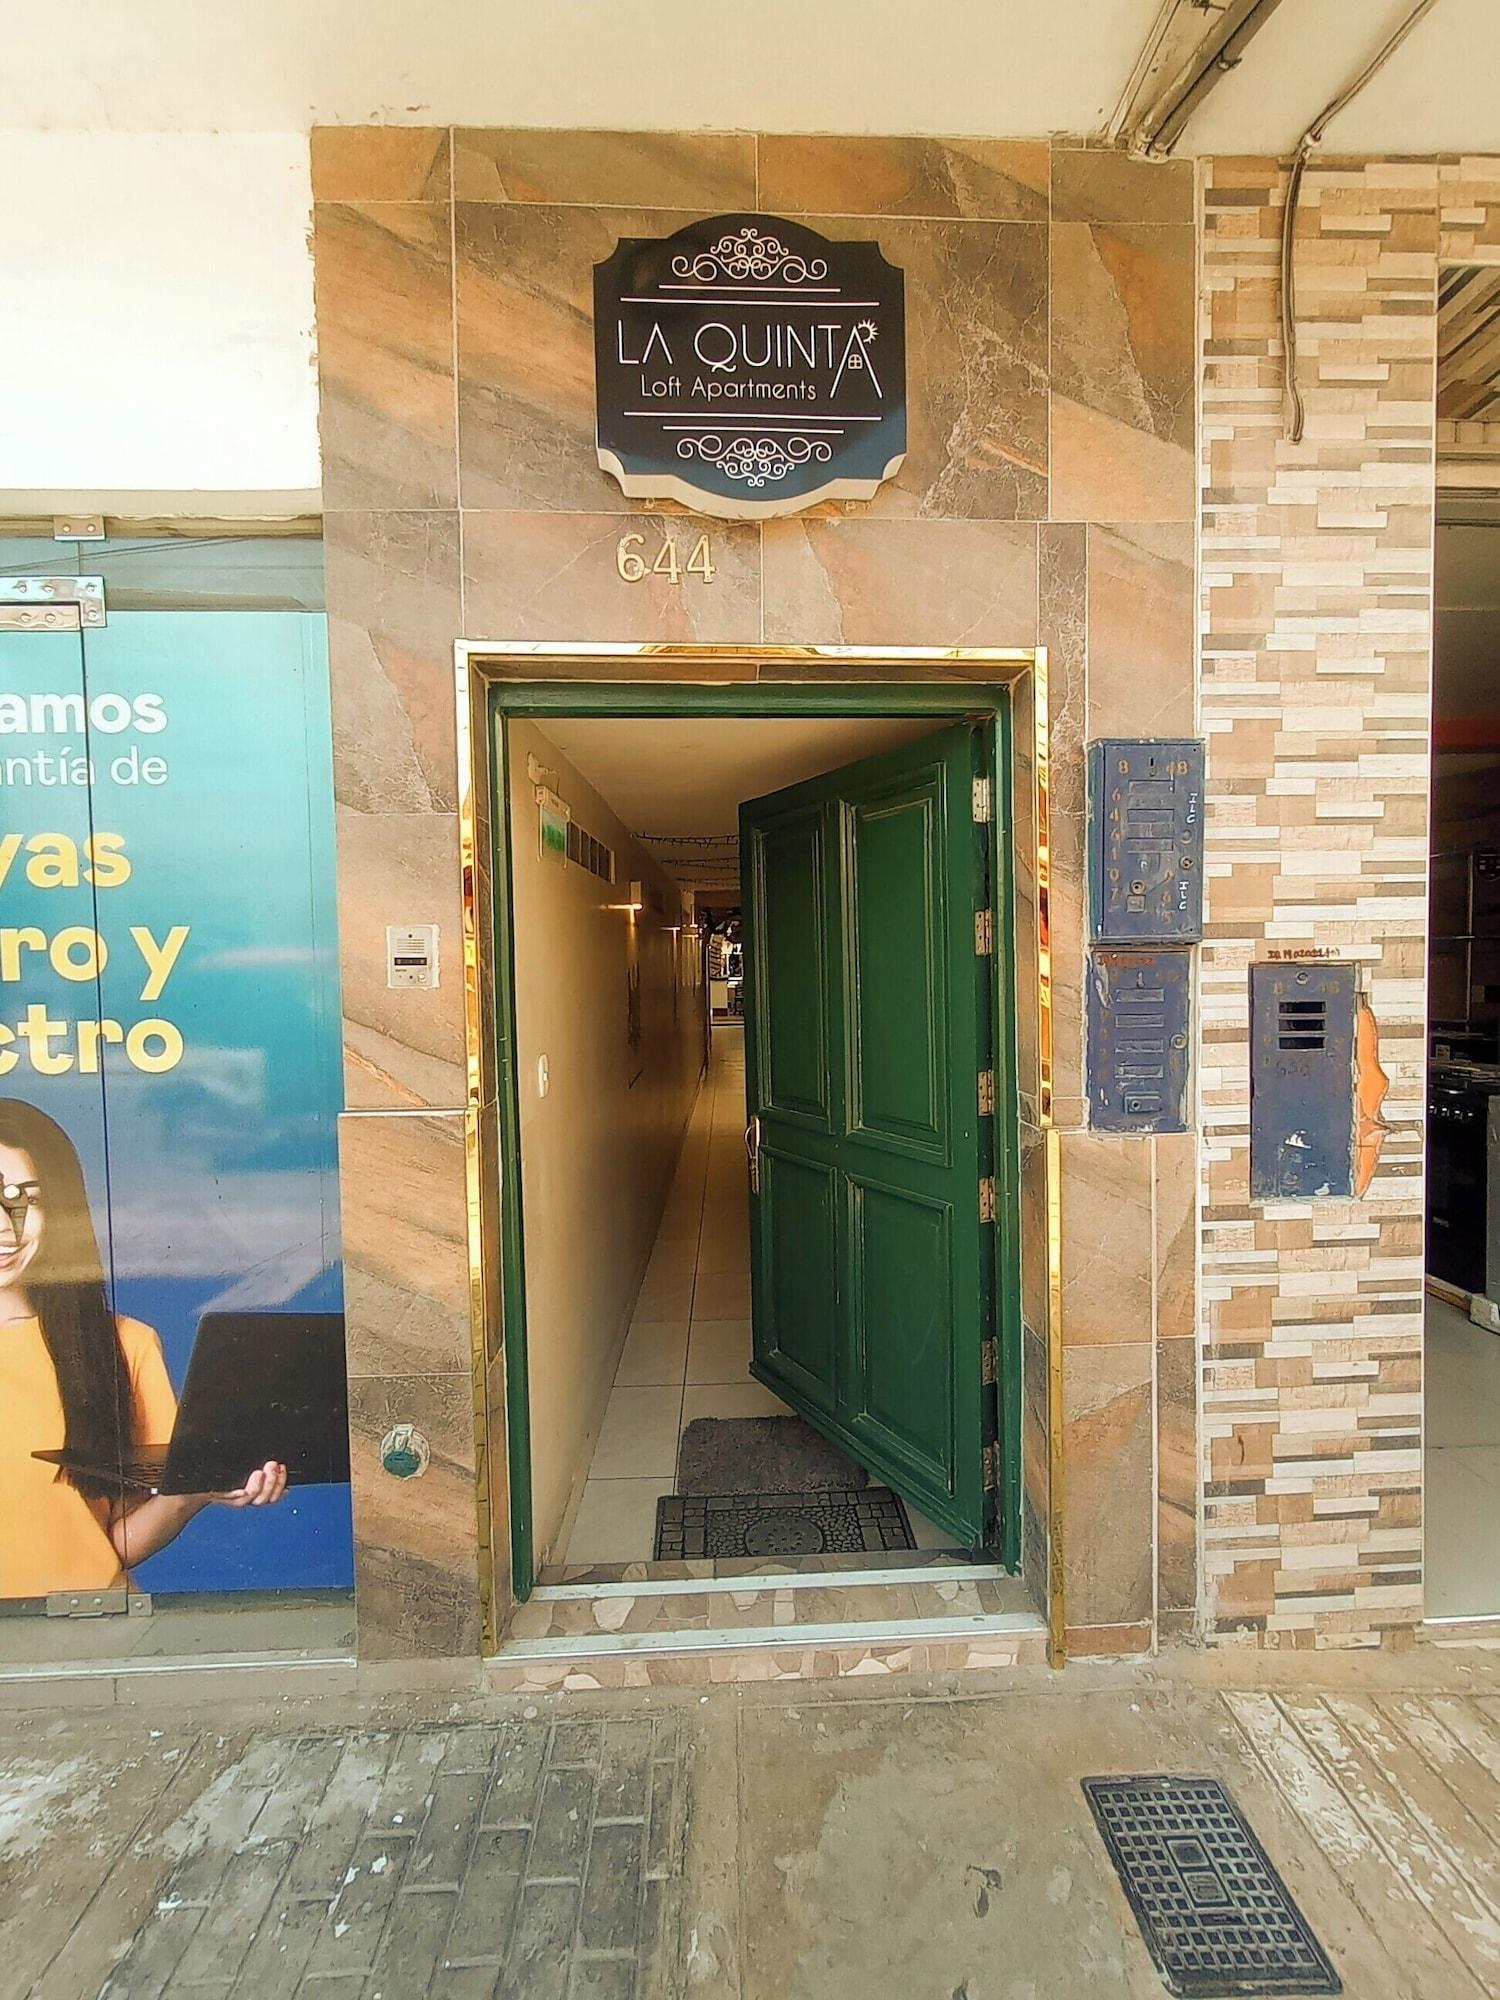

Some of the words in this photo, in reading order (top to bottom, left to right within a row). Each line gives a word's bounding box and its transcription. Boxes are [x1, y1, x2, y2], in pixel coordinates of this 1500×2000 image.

[616, 319, 673, 365] LA
[694, 319, 883, 399] QUINTA
[641, 374, 681, 398] Loft
[691, 376, 817, 402] Apartments
[616, 533, 717, 585] 644
[0, 691, 168, 735] amos
[0, 745, 96, 787] ntía
[110, 745, 169, 786] de
[0, 925, 109, 983] ro
[128, 925, 191, 1001] y
